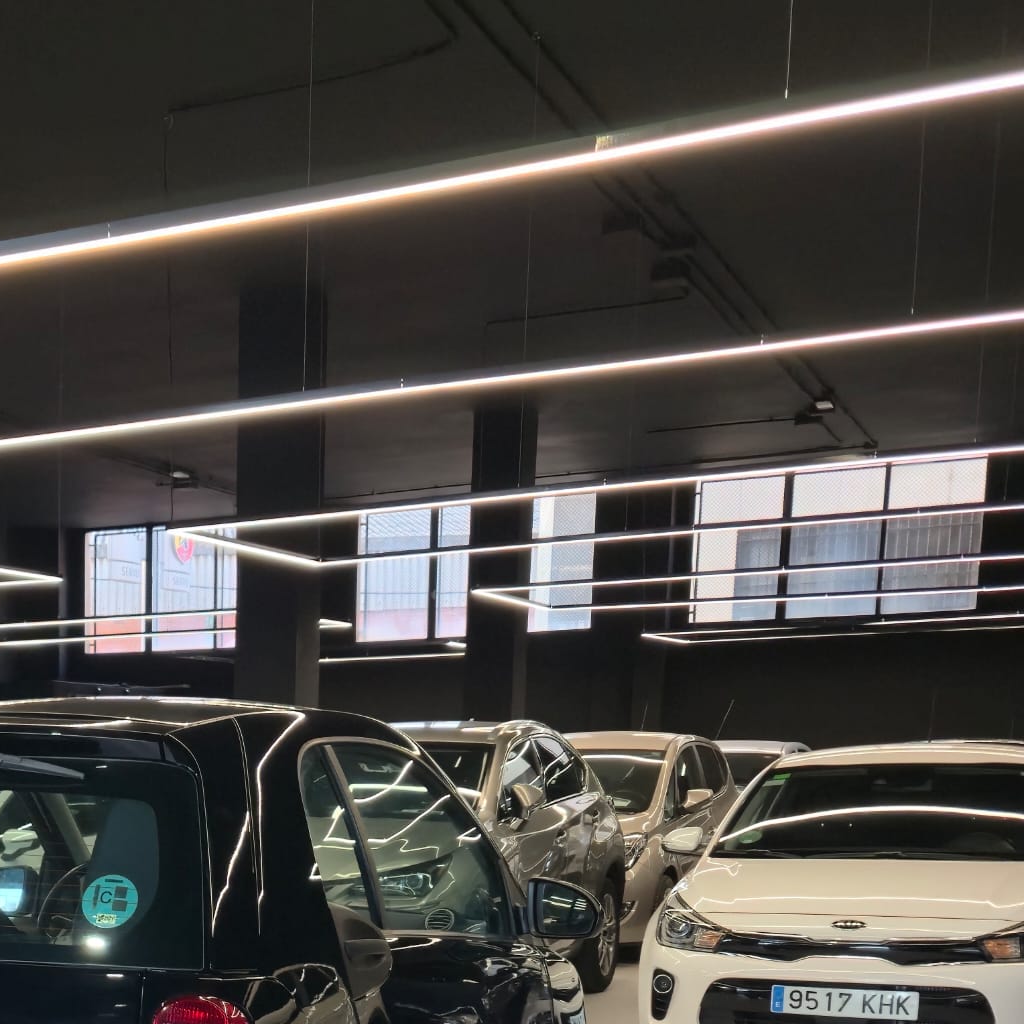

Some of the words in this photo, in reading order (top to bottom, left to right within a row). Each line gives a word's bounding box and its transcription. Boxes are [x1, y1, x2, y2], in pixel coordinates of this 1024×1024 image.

[100, 890, 113, 904] C
[788, 989, 852, 1013] 9517
[861, 993, 912, 1016] KHK
